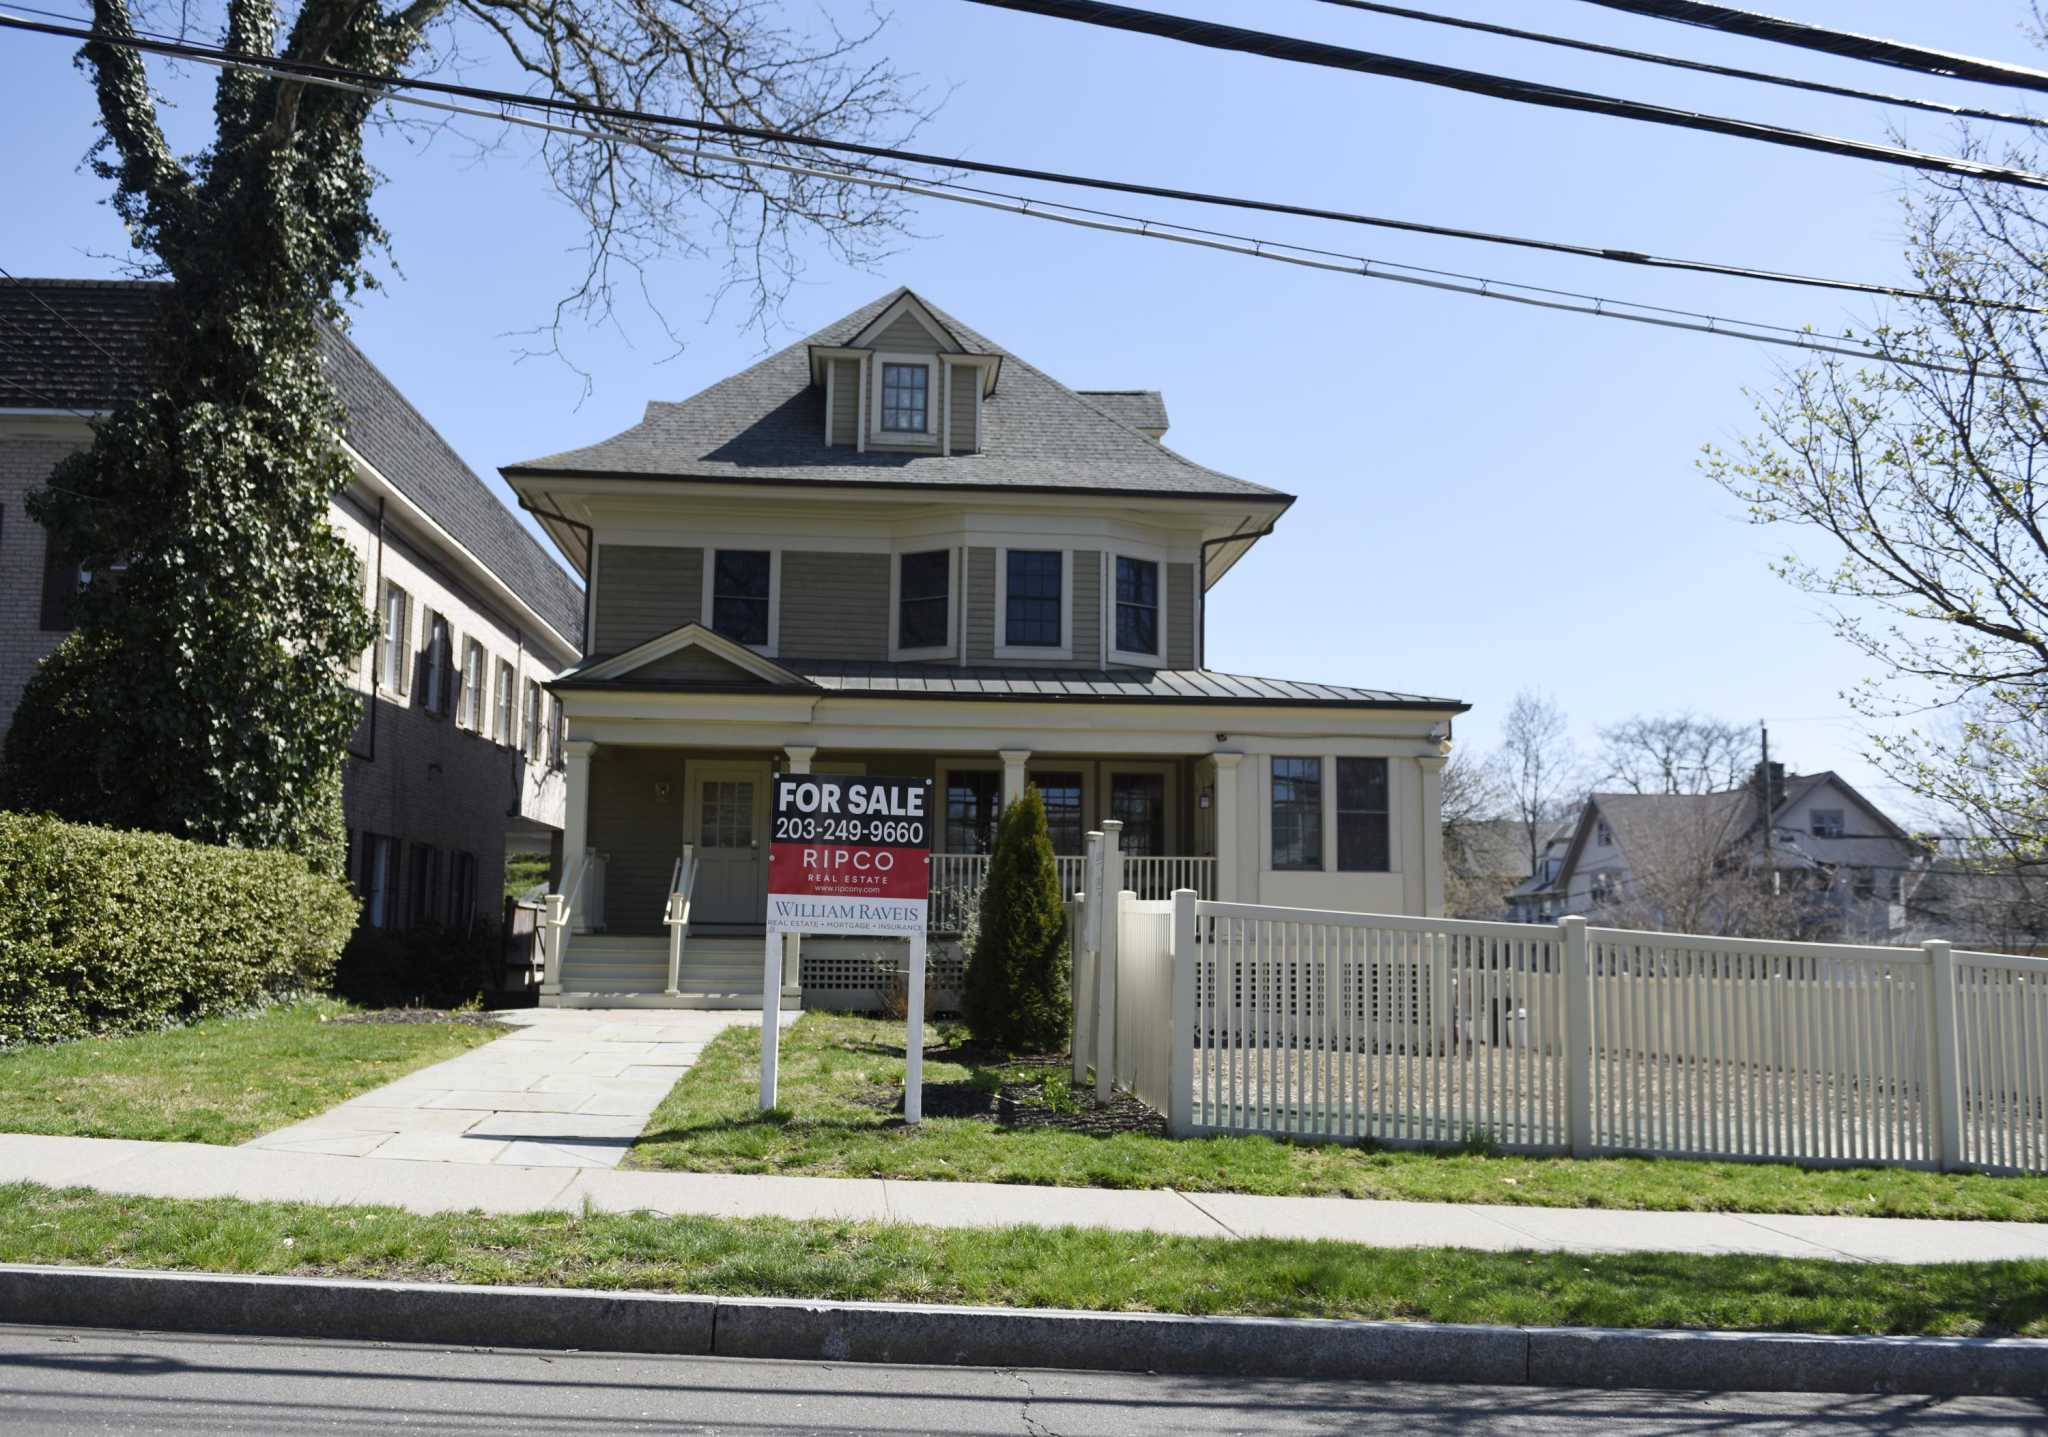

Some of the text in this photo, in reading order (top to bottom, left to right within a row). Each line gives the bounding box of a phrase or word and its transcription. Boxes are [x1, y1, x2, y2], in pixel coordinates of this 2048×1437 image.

[779, 782, 925, 817] FOR SALE
[775, 817, 924, 844] 203-249-9660
[803, 849, 894, 871] RIPCO
[808, 874, 888, 884] REAL ESTATE
[815, 885, 880, 894] www.ripcony.com
